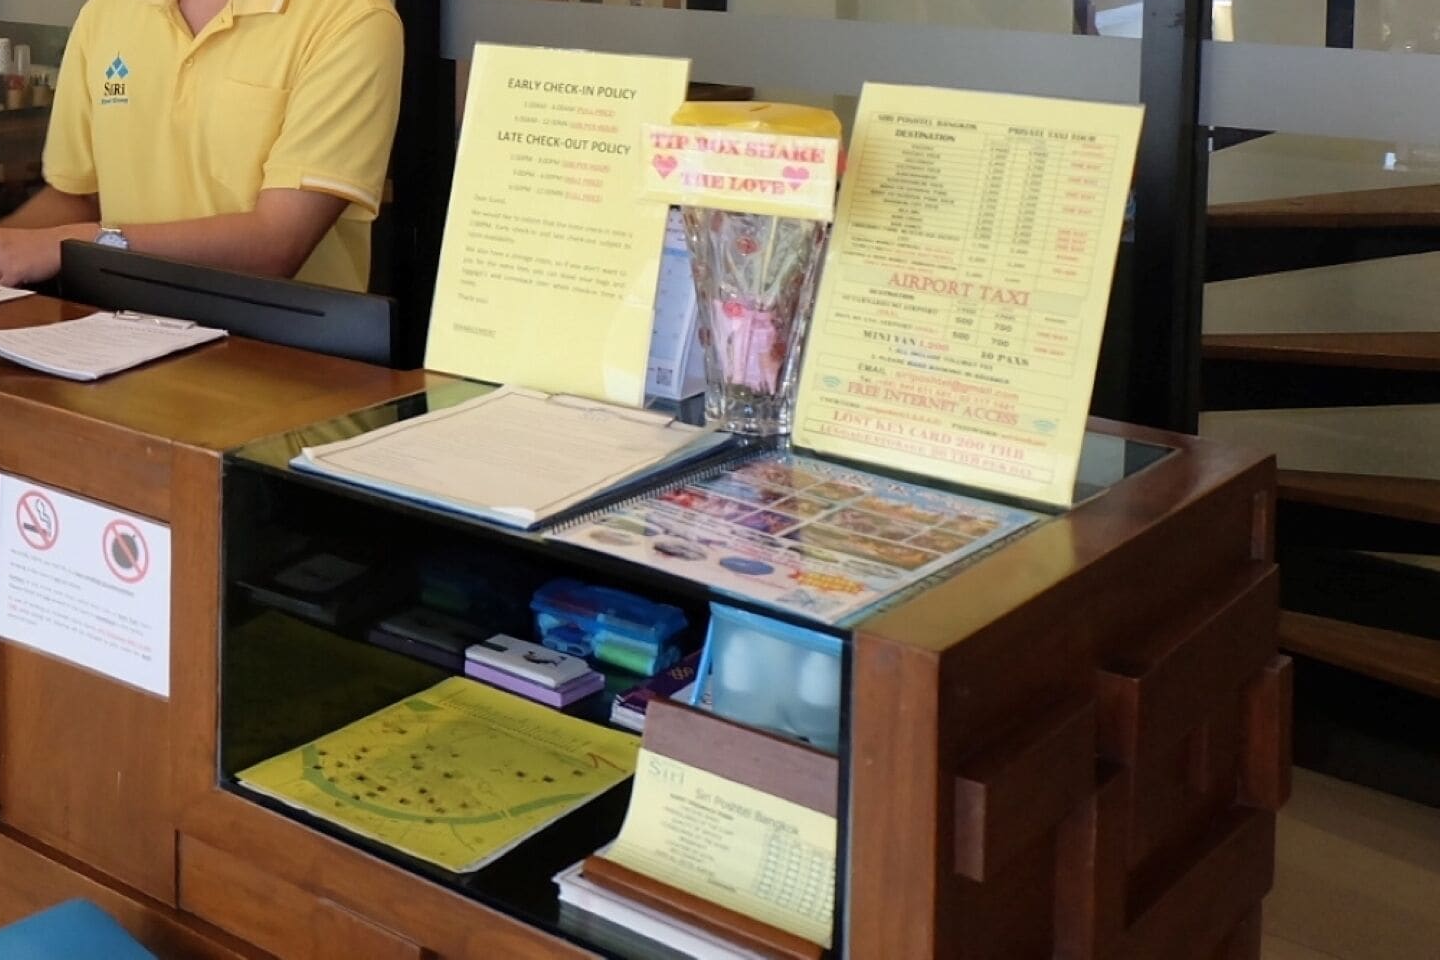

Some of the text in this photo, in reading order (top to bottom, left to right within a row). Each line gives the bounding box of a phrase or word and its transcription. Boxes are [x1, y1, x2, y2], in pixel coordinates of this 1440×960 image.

[508, 77, 637, 100] EARLY CHECK-IN POLICY
[498, 131, 631, 155] LATE CHECK-OUT POLICY
[650, 133, 688, 150] TIP
[745, 141, 825, 163] SHARE
[895, 129, 956, 142] DESTINATION
[728, 176, 785, 195] LOVE
[887, 272, 1030, 306] AIRPORT TAXI
[848, 381, 881, 398] FREE
[884, 387, 958, 414] INTERNET
[962, 404, 1019, 426] ACCESS
[833, 410, 868, 428] LOST
[876, 420, 904, 435] KEY
[910, 426, 952, 445] CARD
